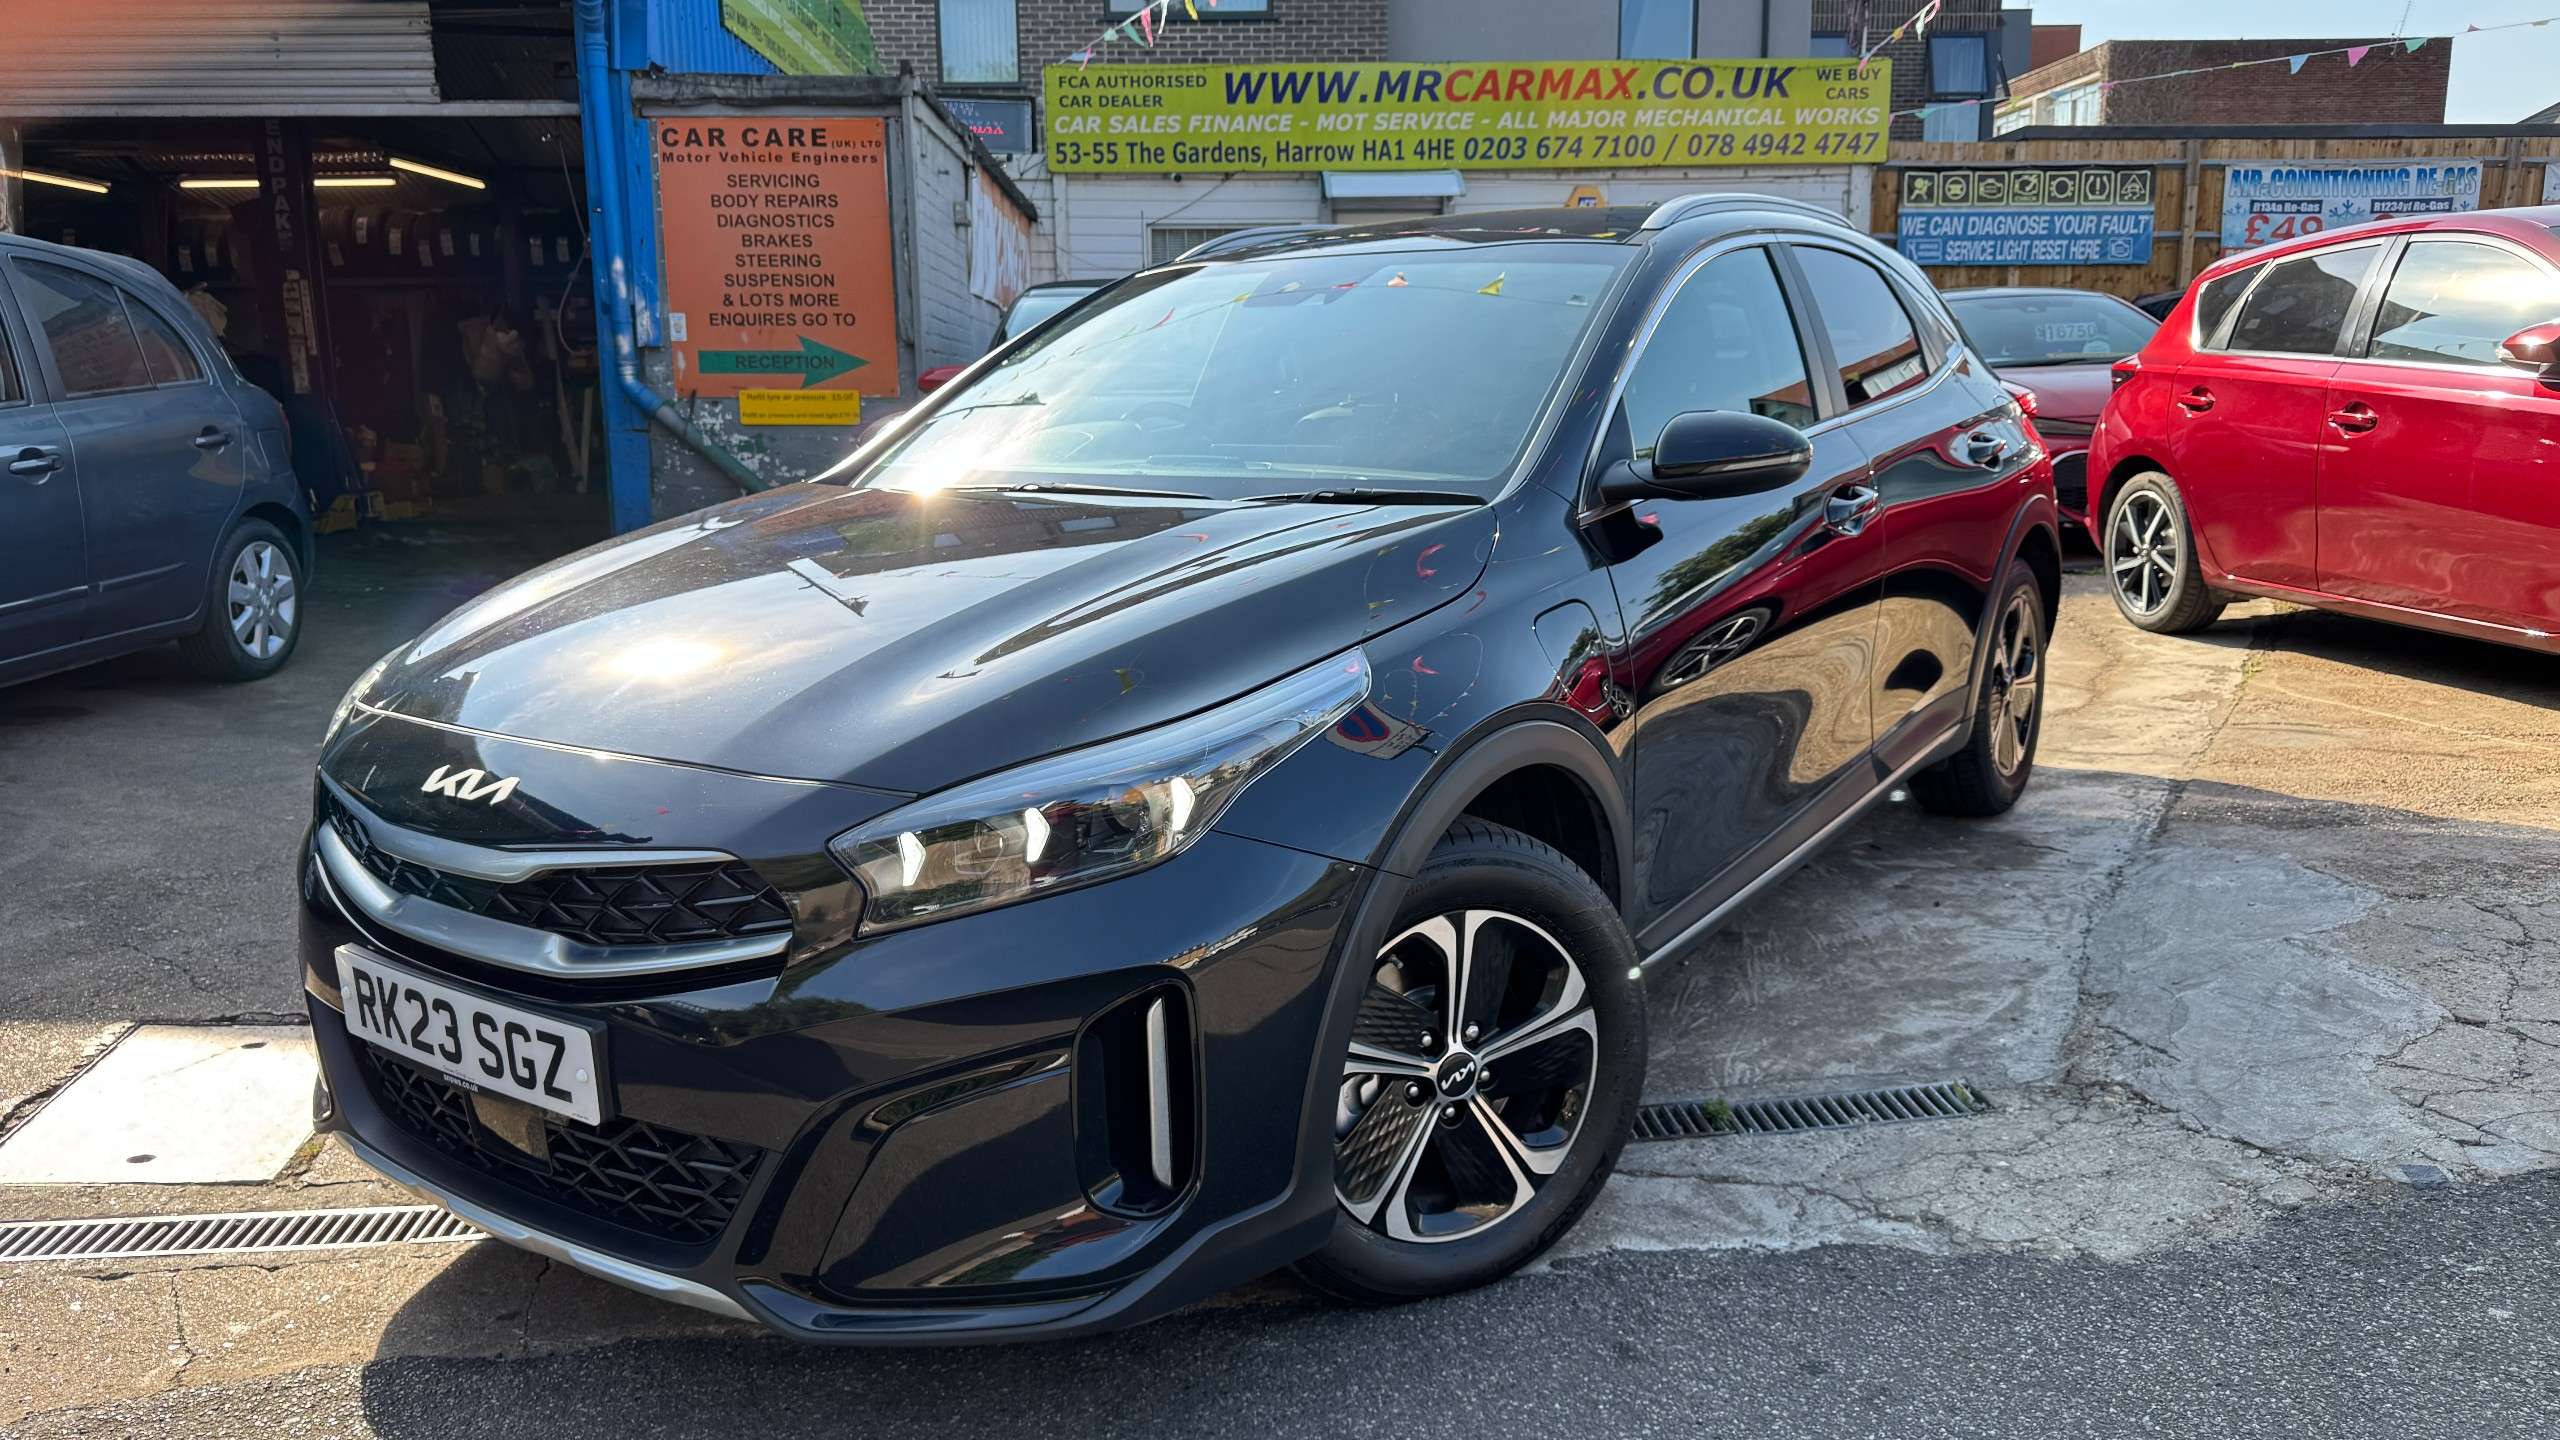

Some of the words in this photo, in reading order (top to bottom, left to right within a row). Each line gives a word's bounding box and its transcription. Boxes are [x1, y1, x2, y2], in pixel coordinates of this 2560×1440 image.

[1058, 75, 1090, 89] FCA
[1095, 74, 1207, 89] AUTHORISED
[1816, 68, 1844, 81] WE
[1847, 68, 1881, 81] BUY
[1225, 67, 1796, 104] WWW.MRCARMAX.CO.UK
[1825, 87, 1870, 100] CARS
[1059, 95, 1092, 108] CAR
[1098, 95, 1164, 108] DEALER
[1054, 116, 1100, 134] CAR
[1108, 115, 1182, 133] SALES
[1188, 114, 1292, 132] FINANCE
[1316, 113, 1369, 131] MOT
[1373, 112, 1473, 131] SERVICE
[1497, 112, 1538, 130] ALL
[1548, 110, 1625, 129] MAJOR
[1633, 109, 1785, 128] MECHANICAL
[1795, 107, 1880, 125] WORKS
[661, 127, 725, 147] CAR
[741, 127, 827, 148] CARE
[860, 140, 882, 148] LTD
[1055, 142, 1119, 164] 53-55
[1126, 142, 1165, 164] The
[1172, 141, 1268, 168] Gardens,
[1275, 140, 1354, 162] Harrow
[1362, 139, 1405, 161] HA1
[1413, 139, 1455, 161] 4HE
[1463, 136, 1527, 161] 0203
[1535, 135, 1583, 160] 674
[1592, 134, 1656, 158] 7100
[1663, 134, 1677, 161] /
[1687, 133, 1734, 156] 078
[1743, 132, 1806, 156] 4942
[1814, 132, 1880, 155] 4747
[662, 152, 711, 163] Motor
[719, 151, 784, 163] Vehicle
[791, 152, 878, 166] Engineers
[727, 174, 820, 188] SERVICING
[2416, 167, 2477, 196] RE-GAS
[711, 194, 759, 208] BODY
[765, 194, 839, 208] REPAIRS
[717, 214, 835, 228] DIAGNOSTICS
[1901, 216, 1927, 236] WE
[1929, 216, 1964, 236] CAN
[1967, 216, 2049, 236] DIAGNOSE
[2054, 215, 2097, 235] YOUR
[2099, 214, 2150, 234] FAULT
[741, 234, 813, 248] BRAKES
[1945, 241, 1994, 261] SERVICE
[1995, 240, 2030, 260] LIGHT
[2030, 240, 2068, 260] RESET
[2069, 240, 2101, 260] HERE
[735, 254, 822, 268] STEERING
[724, 274, 835, 287] SUSPENSION
[723, 294, 735, 307] &
[740, 294, 784, 307] LOTS
[789, 293, 840, 307] MORE
[709, 313, 797, 327] ENQUIRES
[802, 313, 828, 327] GO
[834, 313, 856, 327] TO
[735, 355, 835, 369] RECEPTION
[352, 966, 463, 1065] RK23
[472, 1011, 574, 1104] SGZ
